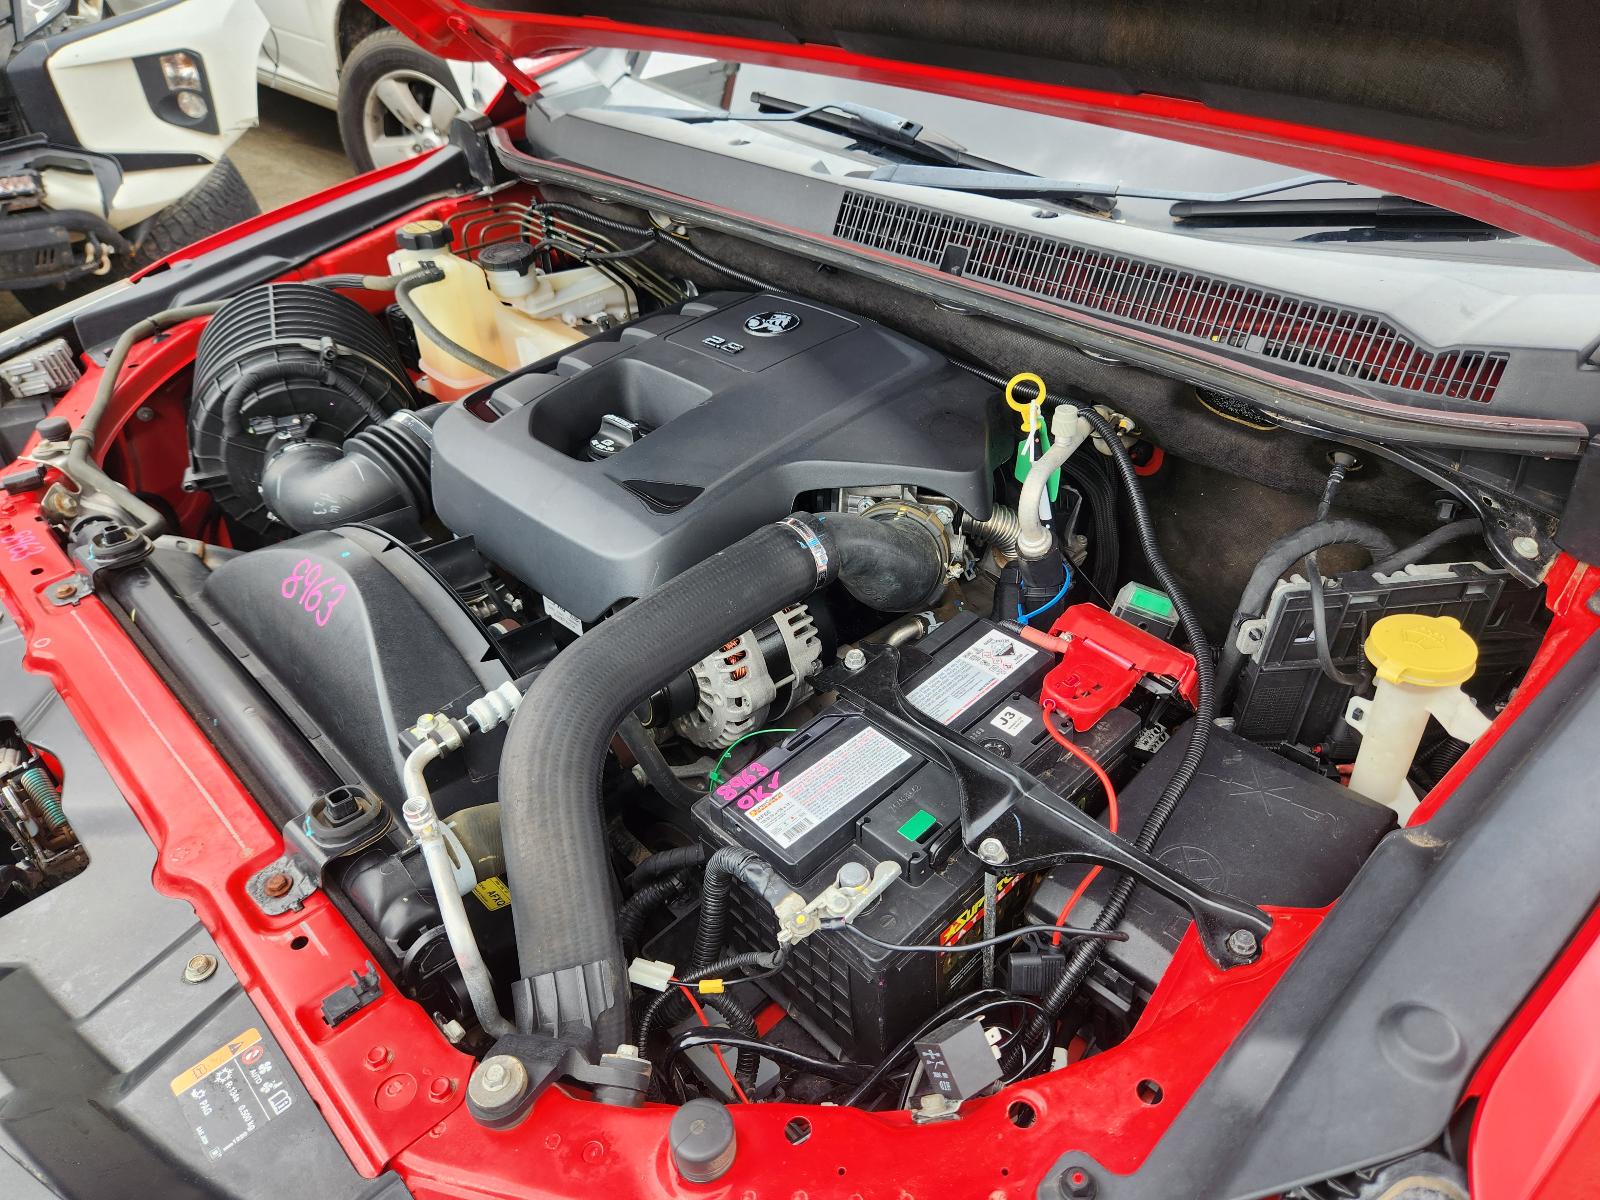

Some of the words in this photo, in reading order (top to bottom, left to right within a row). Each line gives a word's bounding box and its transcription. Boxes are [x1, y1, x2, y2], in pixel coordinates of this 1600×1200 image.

[702, 335, 745, 354] 2.8
[281, 559, 347, 627] 8963
[999, 711, 1016, 726] J3
[716, 762, 769, 801] 8963
[736, 785, 773, 811] OK
[249, 1068, 263, 1085] AUTO
[199, 1100, 212, 1116] PAG
